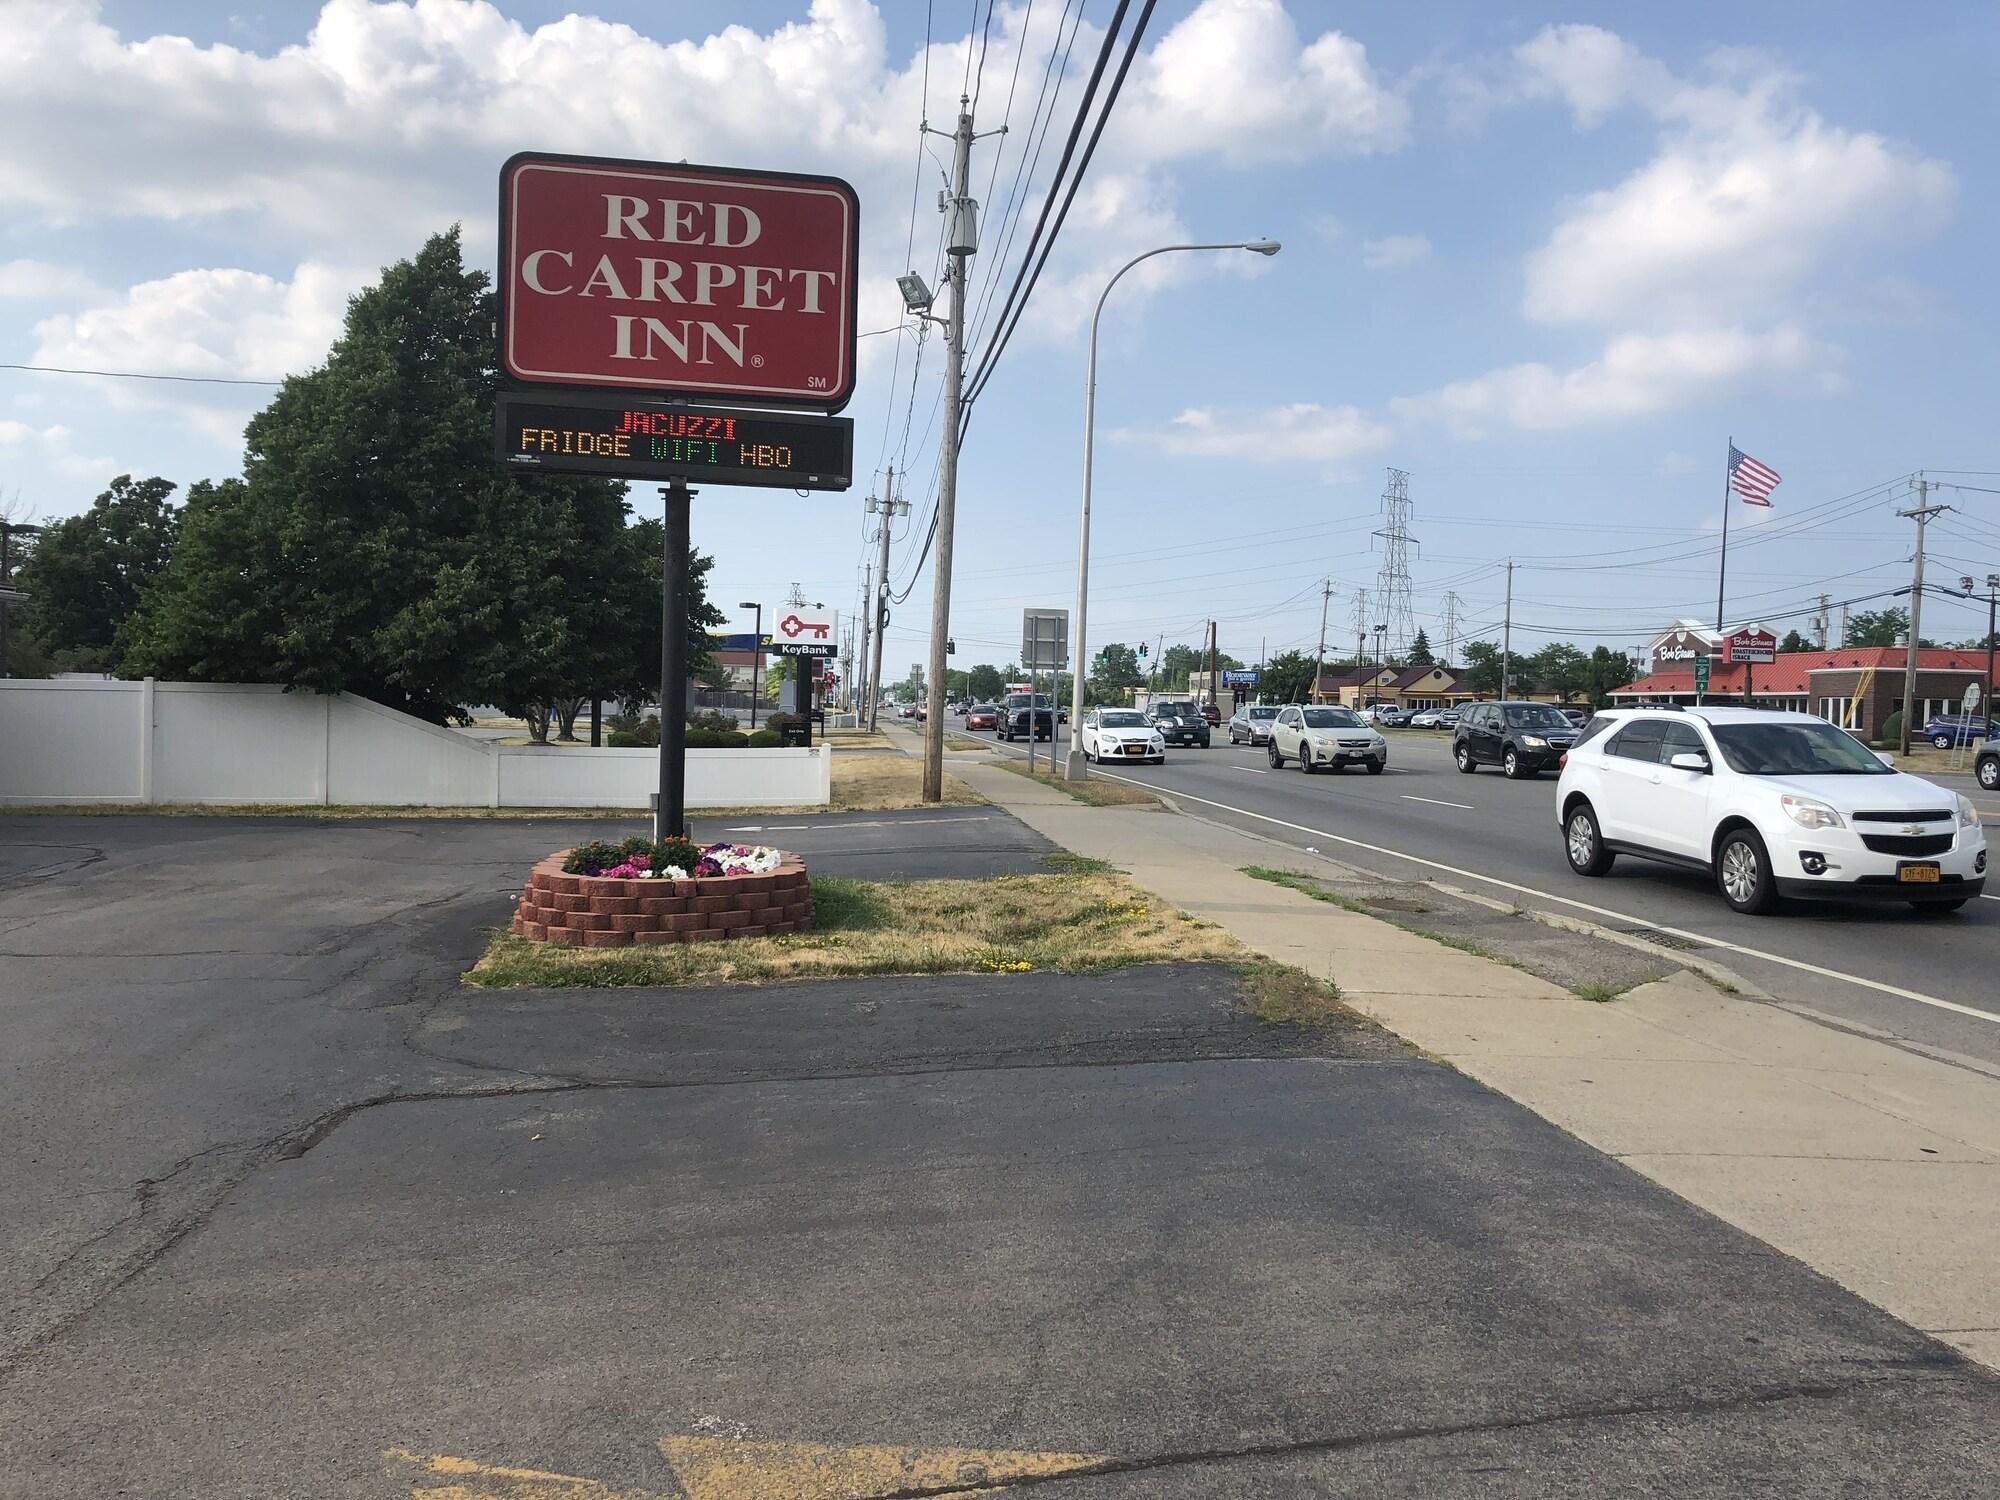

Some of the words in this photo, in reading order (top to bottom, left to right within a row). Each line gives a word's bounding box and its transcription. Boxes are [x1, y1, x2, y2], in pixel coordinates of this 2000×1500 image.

[600, 193, 762, 248] RED
[521, 249, 836, 313] CARPET
[609, 315, 750, 368] INN
[807, 376, 826, 388] SM
[614, 410, 737, 440] JACUZZI
[521, 427, 632, 457] FRIDGE
[650, 437, 719, 463] WIFI
[739, 444, 792, 468] HBO
[782, 645, 829, 655] KeyBank
[1659, 646, 1675, 660] Bob
[1674, 645, 1696, 660] Evans
[1732, 636, 1750, 646] Bob
